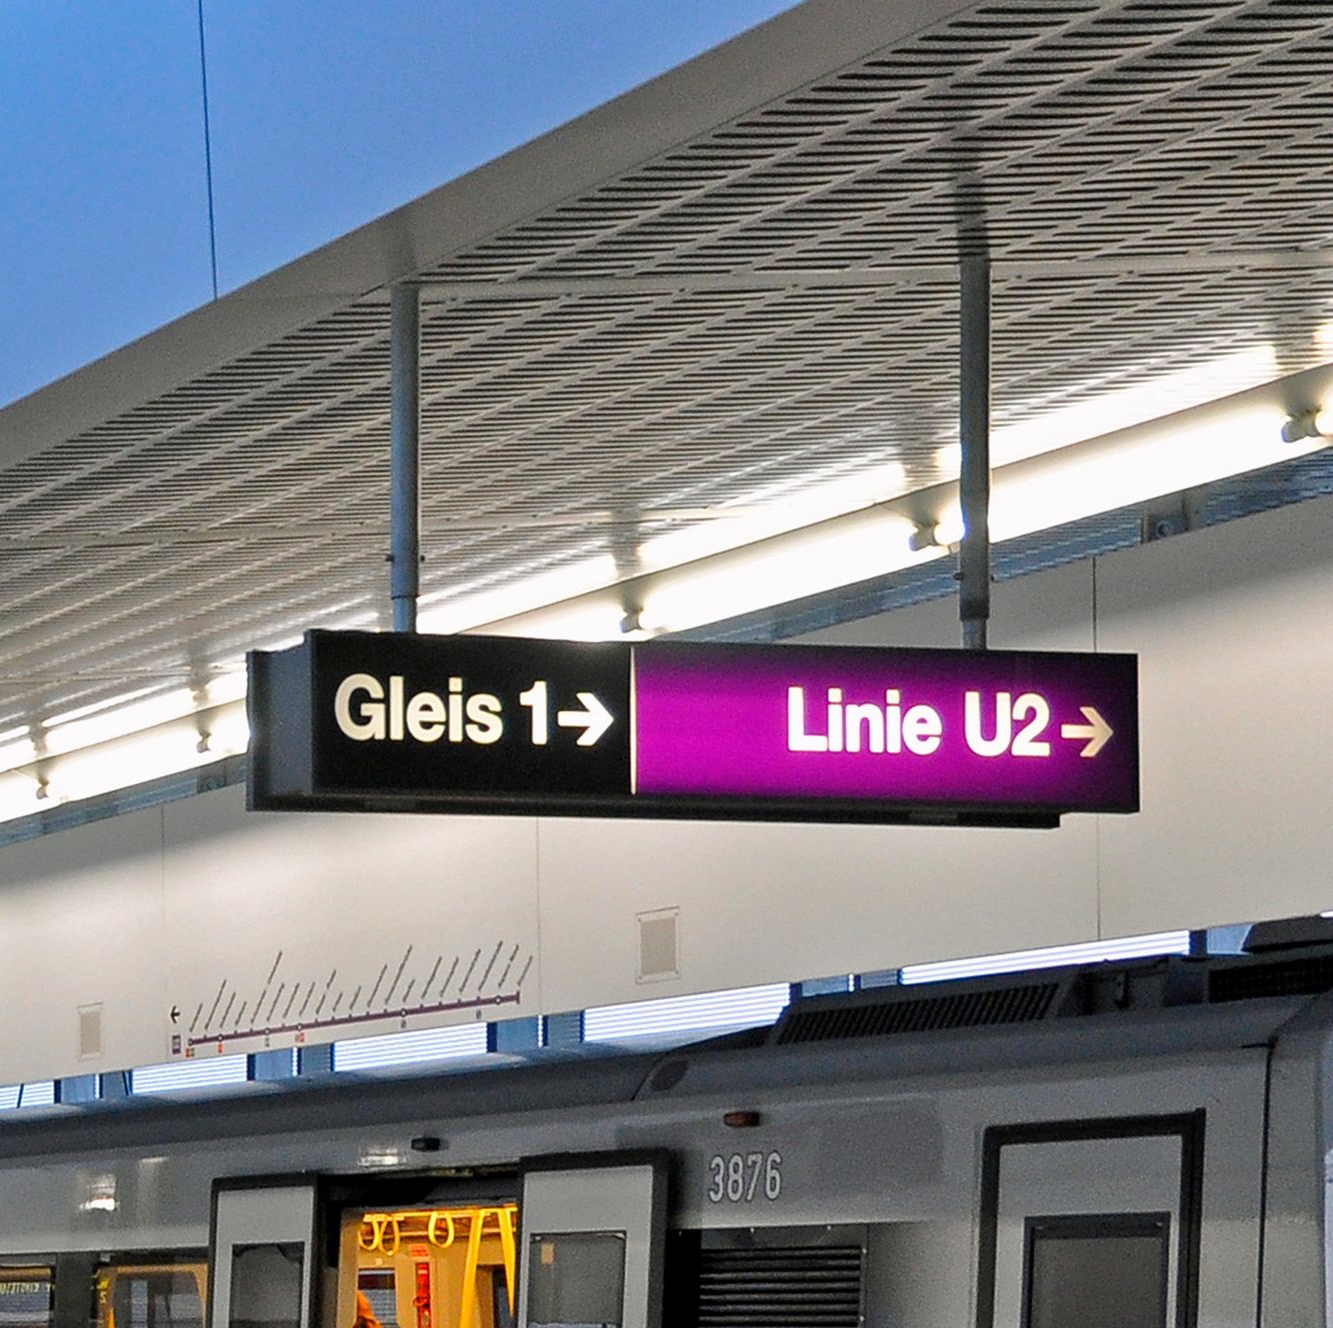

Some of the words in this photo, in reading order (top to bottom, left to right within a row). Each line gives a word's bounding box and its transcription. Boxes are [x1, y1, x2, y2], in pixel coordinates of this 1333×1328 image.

[335, 673, 503, 744] Gleis
[520, 681, 548, 745] 1
[787, 687, 942, 755] Linie
[964, 692, 1051, 757] U2
[709, 1152, 782, 1202] 3876
